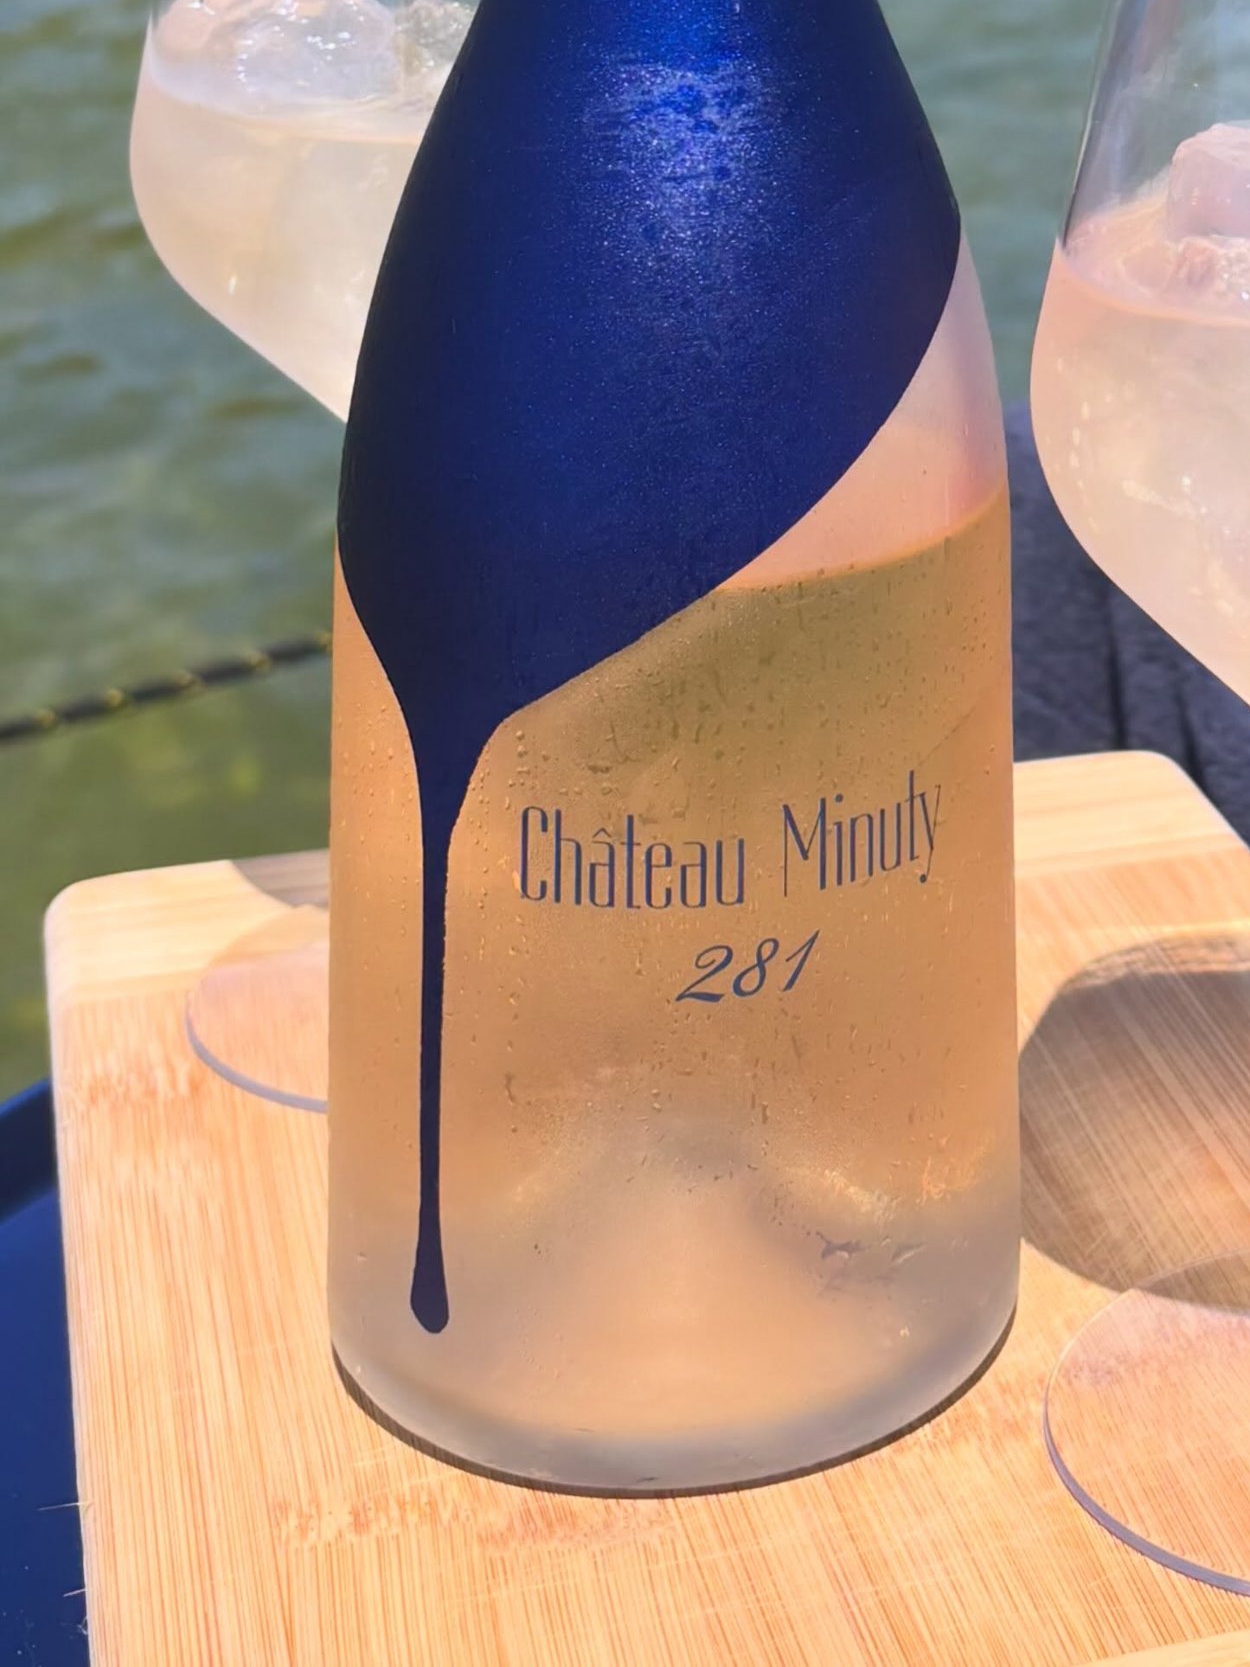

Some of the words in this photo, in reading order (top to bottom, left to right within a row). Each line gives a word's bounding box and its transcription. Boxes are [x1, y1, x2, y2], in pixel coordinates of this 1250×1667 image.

[519, 805, 745, 910] Château
[782, 769, 941, 898] Minuty
[675, 929, 820, 1003] 281
